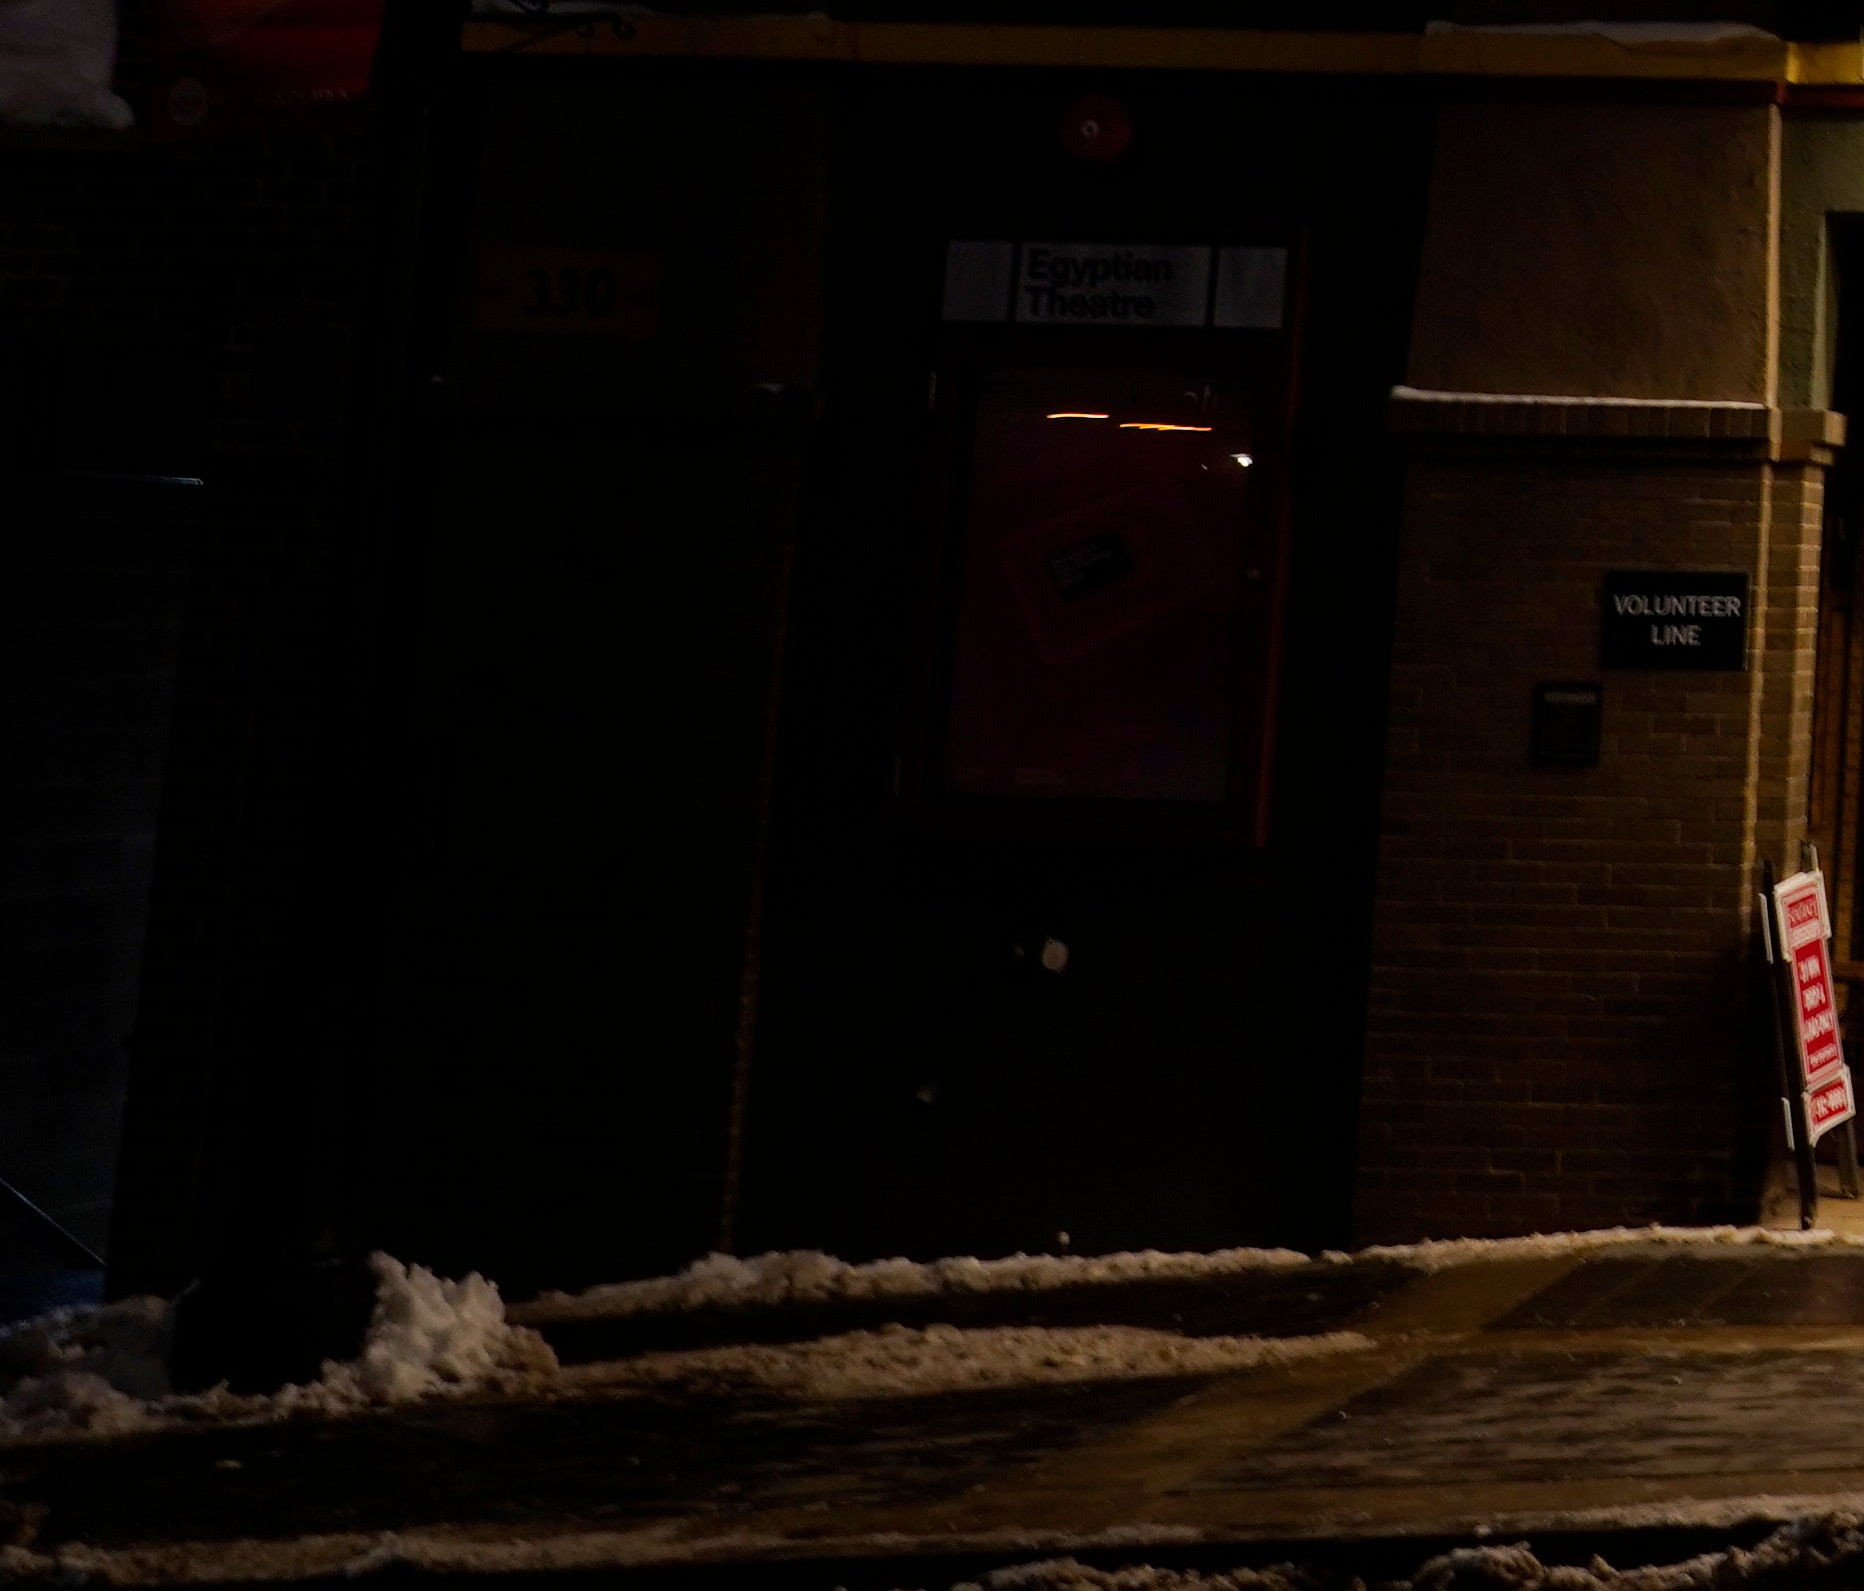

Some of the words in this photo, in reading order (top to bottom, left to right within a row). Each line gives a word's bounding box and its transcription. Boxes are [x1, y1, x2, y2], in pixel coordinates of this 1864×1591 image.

[1029, 249, 1172, 287] Egyptian
[521, 268, 617, 315] 330
[1025, 285, 1156, 319] Theatre
[1612, 594, 1741, 618] VOLUNTEER
[1650, 622, 1702, 647] LINE
